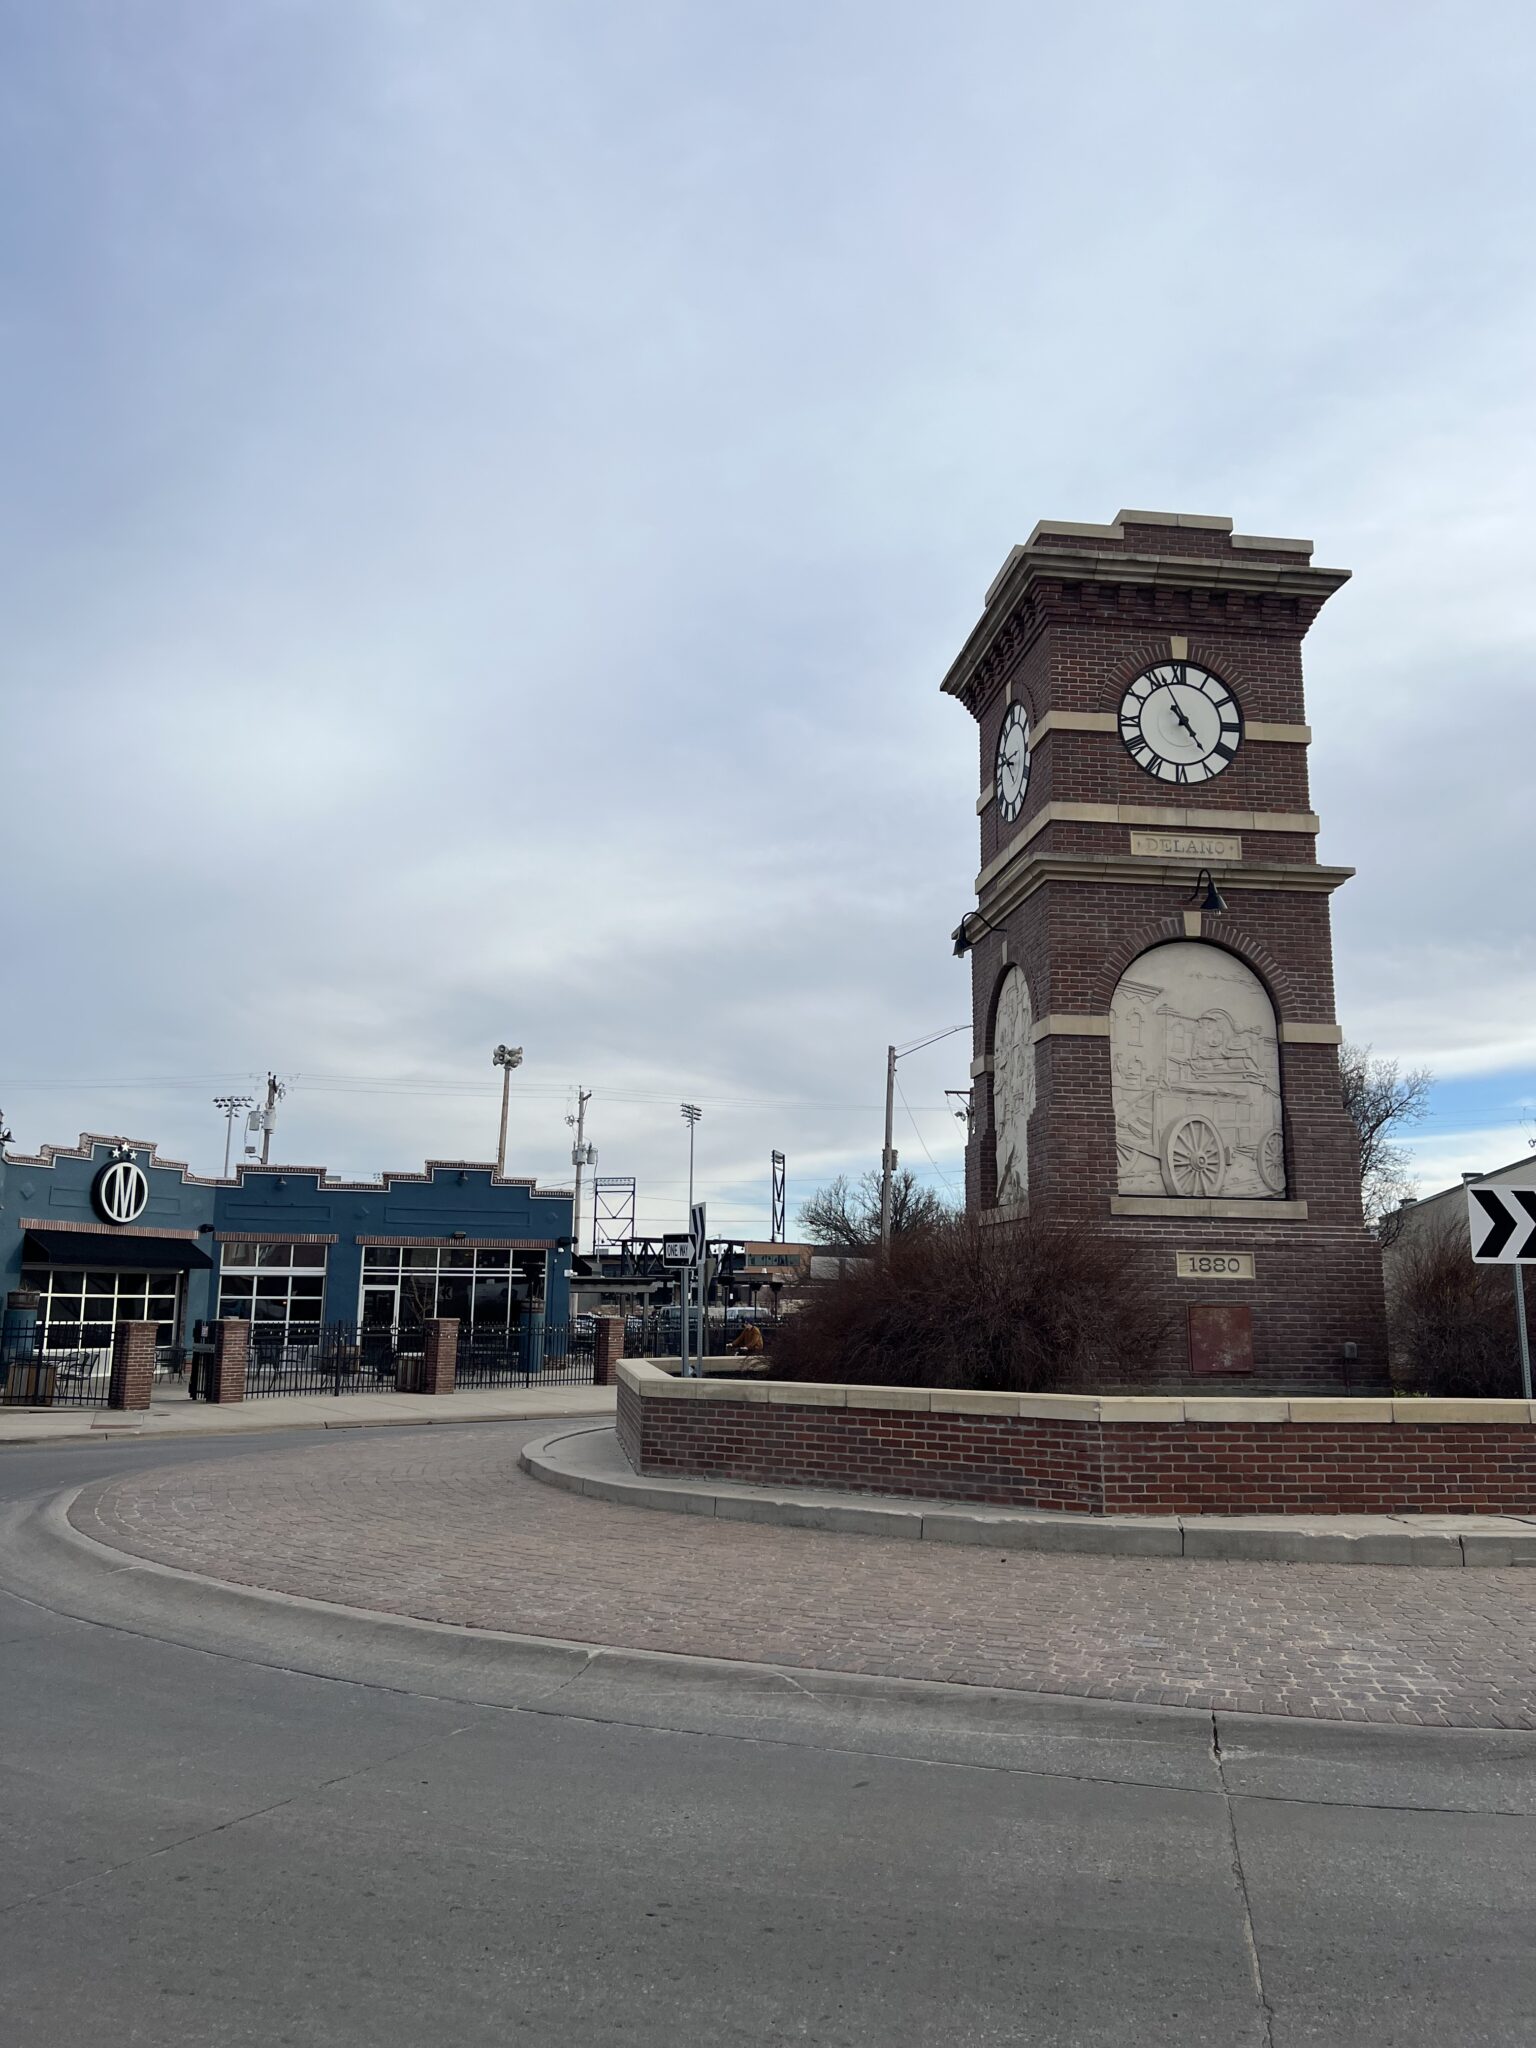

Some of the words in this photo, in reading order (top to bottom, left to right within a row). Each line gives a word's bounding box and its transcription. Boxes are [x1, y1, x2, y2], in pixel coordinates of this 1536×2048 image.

[1144, 670, 1161, 690] XI
[1171, 665, 1187, 684] XII
[1127, 688, 1146, 705] X
[1145, 838, 1225, 855] DELANO
[667, 1244, 678, 1257] ONE
[679, 1244, 689, 1257] WAY
[1189, 1256, 1240, 1273] 1880
